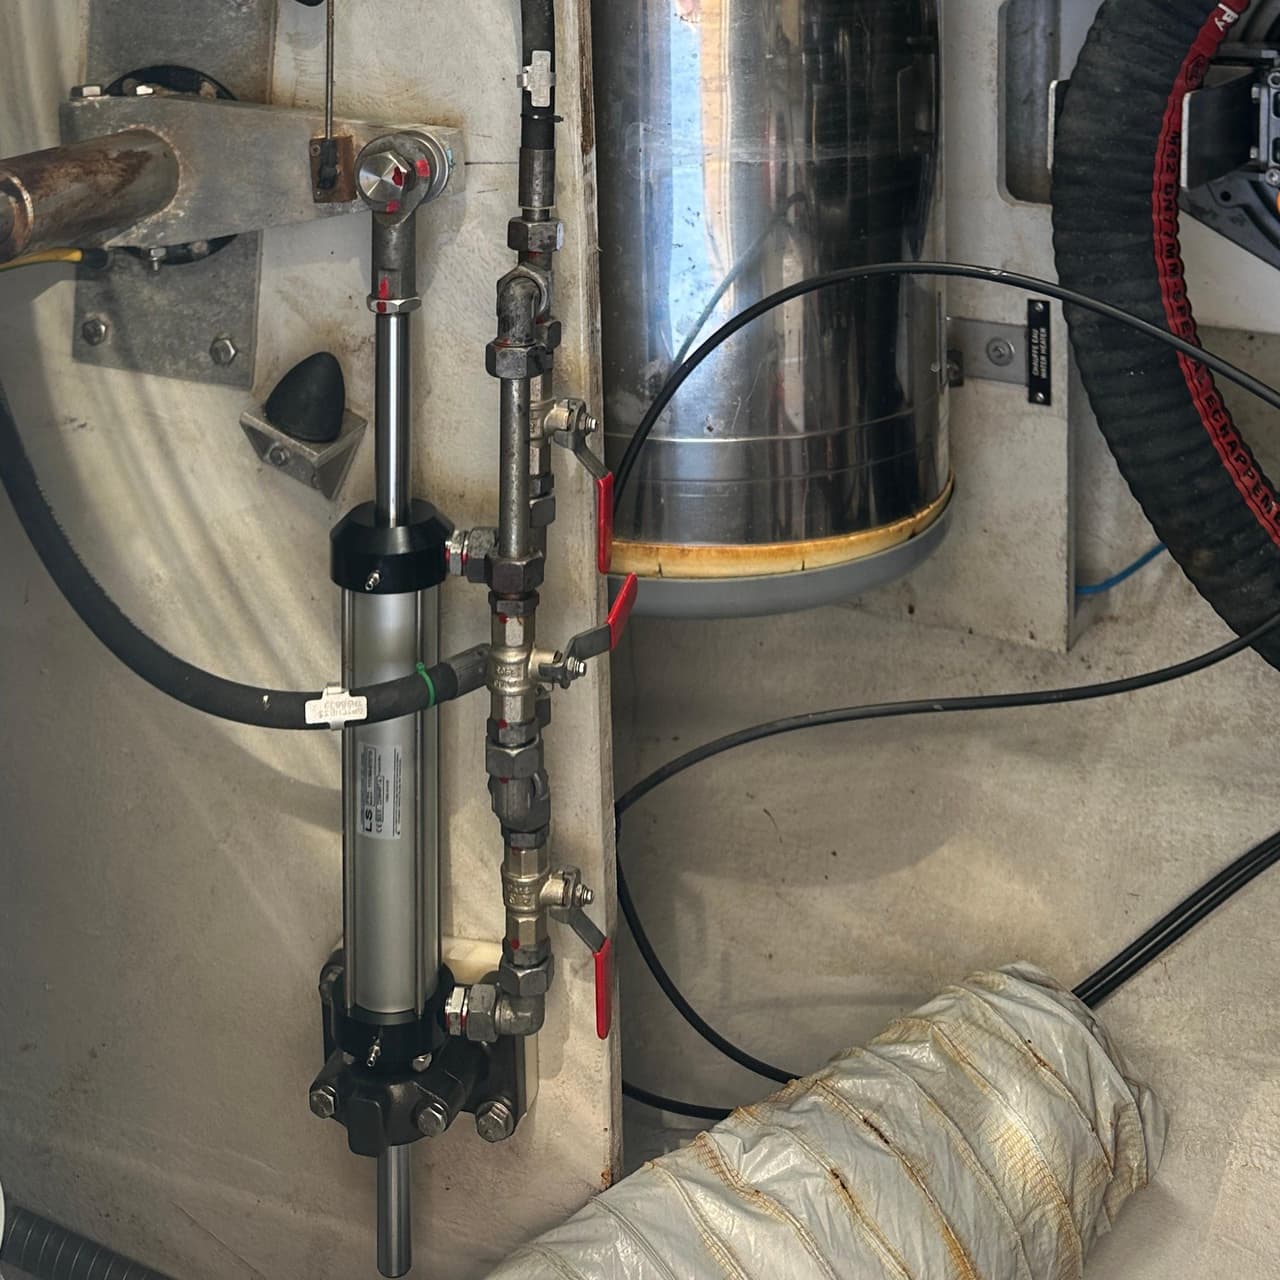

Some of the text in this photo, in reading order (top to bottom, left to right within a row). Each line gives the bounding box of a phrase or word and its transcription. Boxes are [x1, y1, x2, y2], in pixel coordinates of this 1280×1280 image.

[1031, 328, 1039, 377] CHAUFFE EAU
[1039, 327, 1047, 379] WATER HEATER
[365, 808, 373, 833] LS
